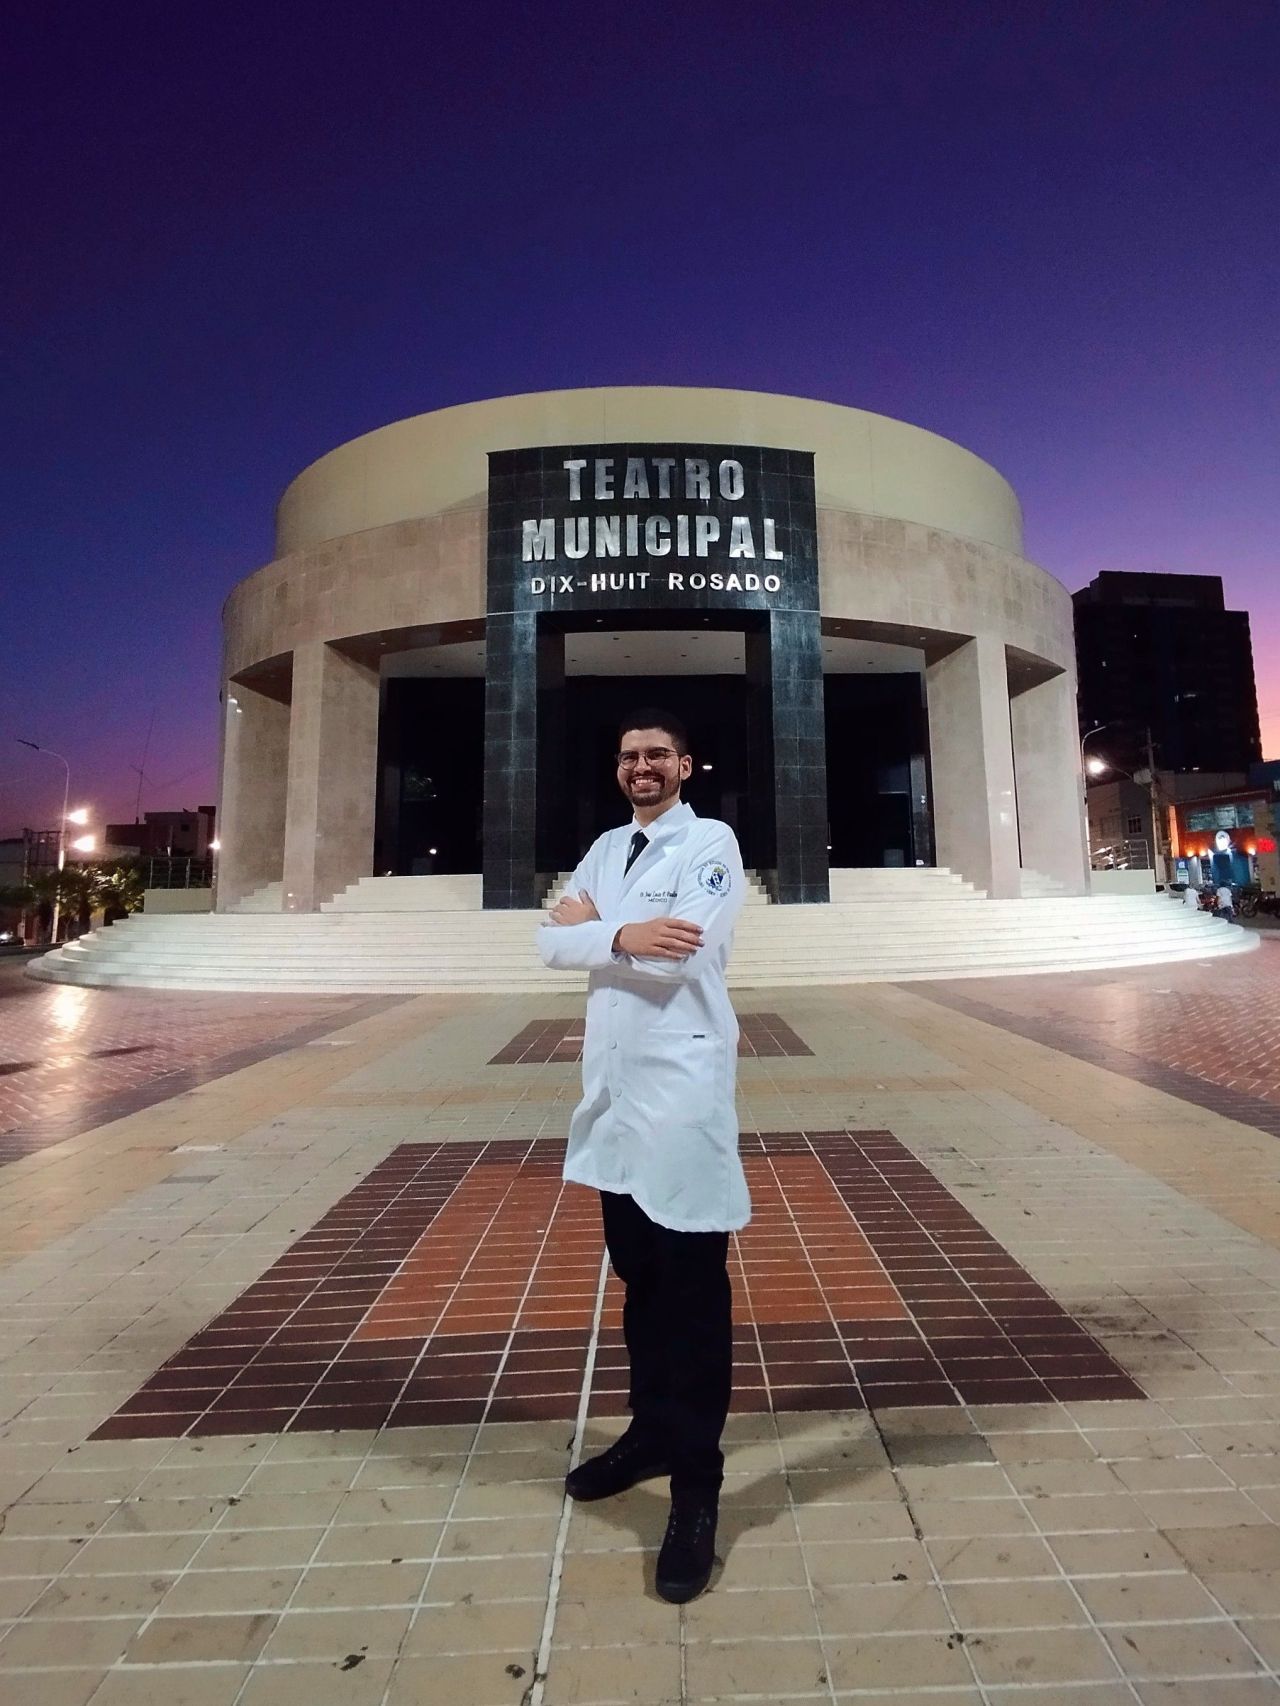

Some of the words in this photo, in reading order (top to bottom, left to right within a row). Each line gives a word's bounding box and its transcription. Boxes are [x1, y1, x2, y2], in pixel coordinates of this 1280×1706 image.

[563, 458, 745, 501] TEATRO
[522, 515, 784, 562] MUNICIPAL
[531, 572, 650, 595] DIX-HUIT
[668, 573, 781, 593] ROSADO
